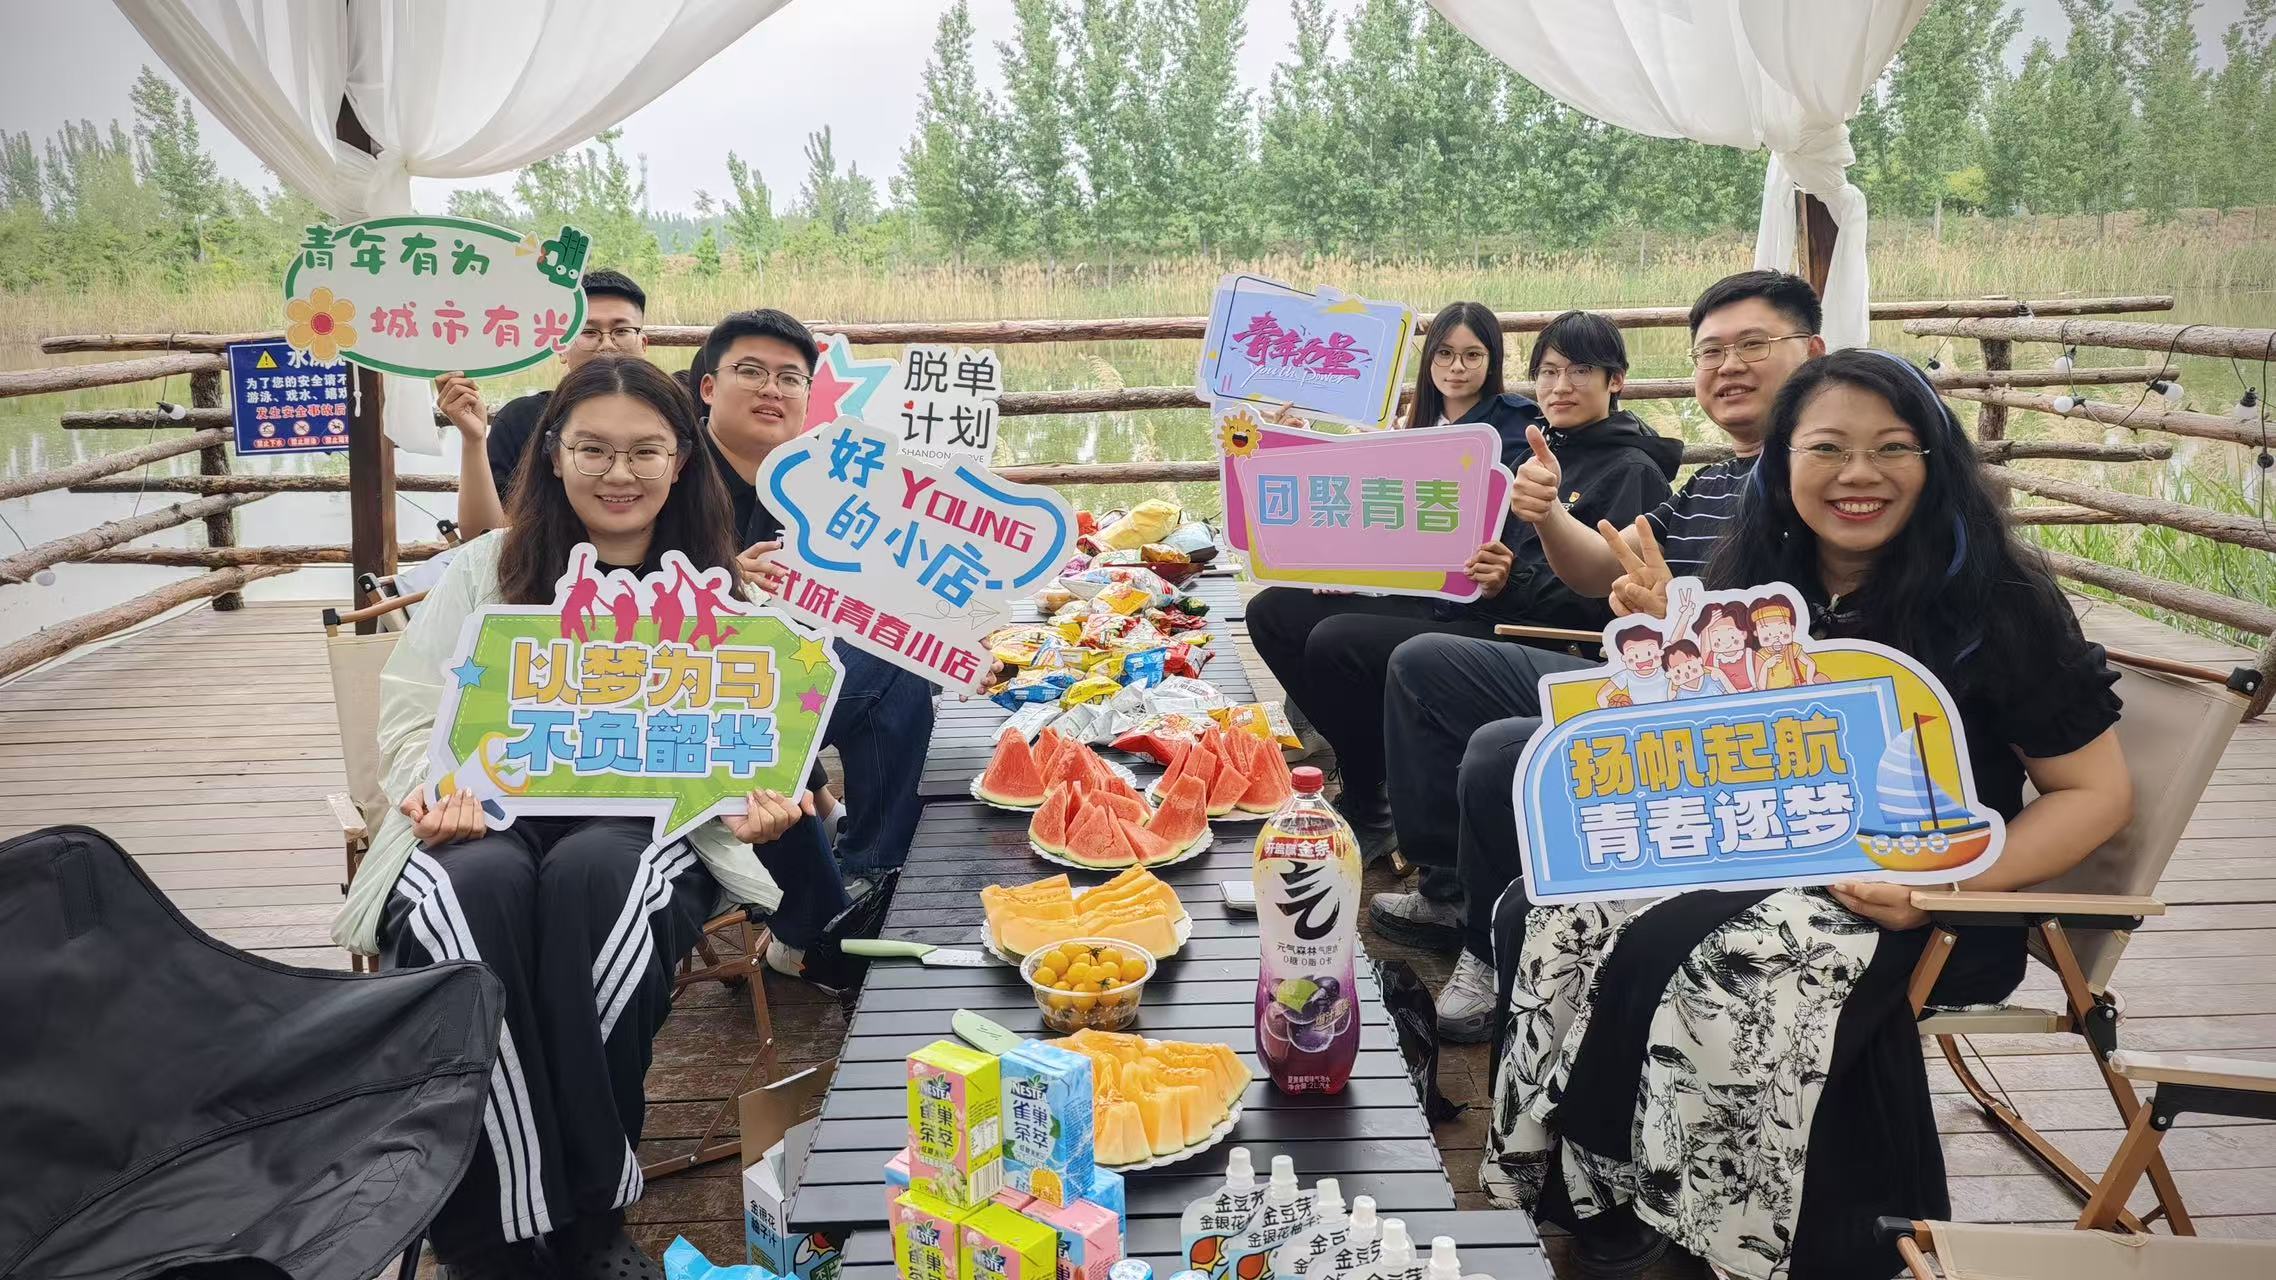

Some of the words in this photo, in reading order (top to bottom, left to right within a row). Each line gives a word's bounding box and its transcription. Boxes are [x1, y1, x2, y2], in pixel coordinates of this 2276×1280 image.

[301, 225, 490, 276] 青年有为
[370, 301, 572, 352] 城市有光
[1232, 311, 1370, 380] 青年力量
[904, 350, 996, 397] 脱单
[255, 403, 347, 420] 发生安全事故后
[900, 401, 992, 450] 计划
[901, 448, 951, 460] SHANDON
[827, 428, 888, 488] 好
[900, 467, 1036, 553] YOUNG
[1256, 474, 1463, 534] 团聚青春
[825, 494, 990, 609] 的小店
[511, 641, 775, 709] 以梦为马
[507, 709, 773, 774] 不负韶华
[1567, 710, 1850, 799] 扬帆起航
[1579, 781, 1857, 867] 青春逐梦
[1276, 942, 1317, 957] 元气森林
[920, 1099, 952, 1127] 雀巢
[1013, 1099, 1048, 1128] 雀巢
[920, 1121, 953, 1148] 茶萃
[1014, 1120, 1048, 1149] 茶萃
[750, 1199, 776, 1231] 金银花
[1215, 1190, 1265, 1214] 金豆芽
[1262, 1196, 1312, 1228] 金豆芽
[751, 1216, 777, 1248] 柚子汁
[1200, 1212, 1256, 1231] 金银花
[1309, 1228, 1351, 1255] 金豆
